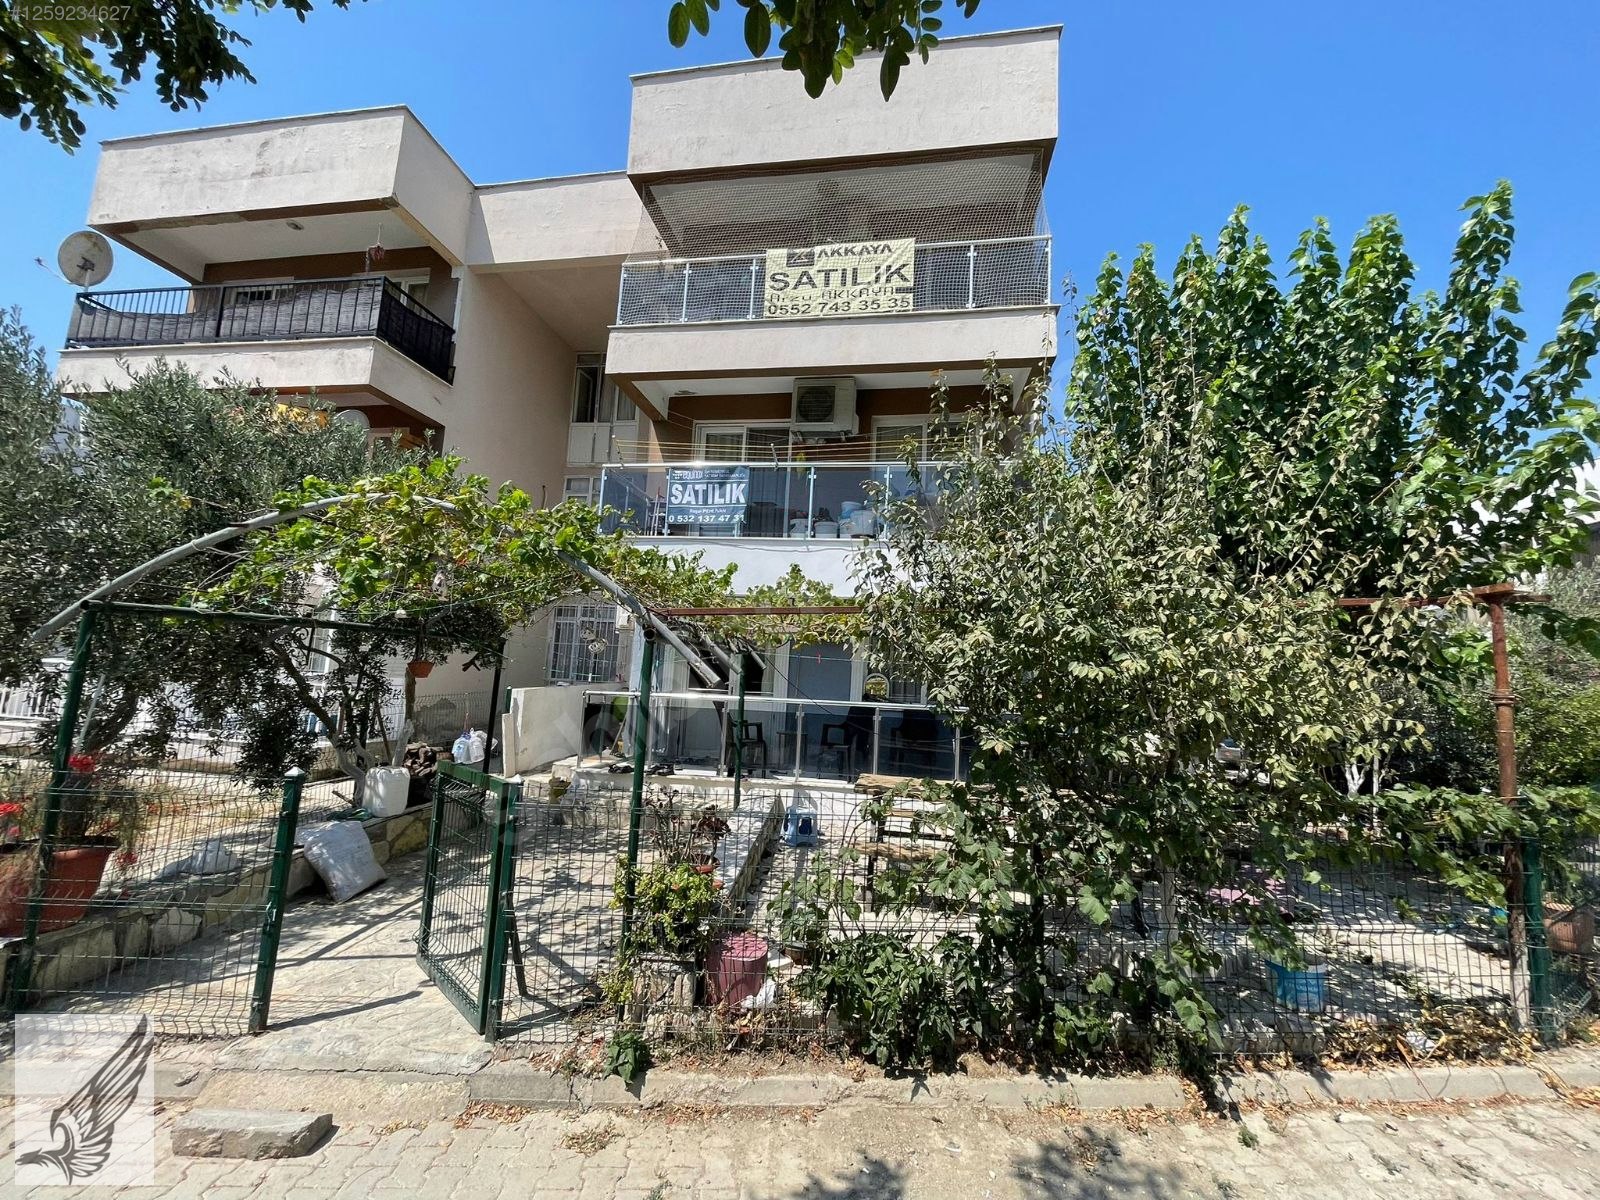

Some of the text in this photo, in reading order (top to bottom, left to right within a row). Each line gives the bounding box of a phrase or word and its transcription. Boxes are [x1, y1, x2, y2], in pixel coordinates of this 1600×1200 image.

[817, 244, 892, 258] AKKAYA
[767, 297, 911, 315] 0552 743 35 35
[670, 483, 746, 505] SATILIK
[668, 515, 675, 523] 0
[718, 514, 731, 522] 47
